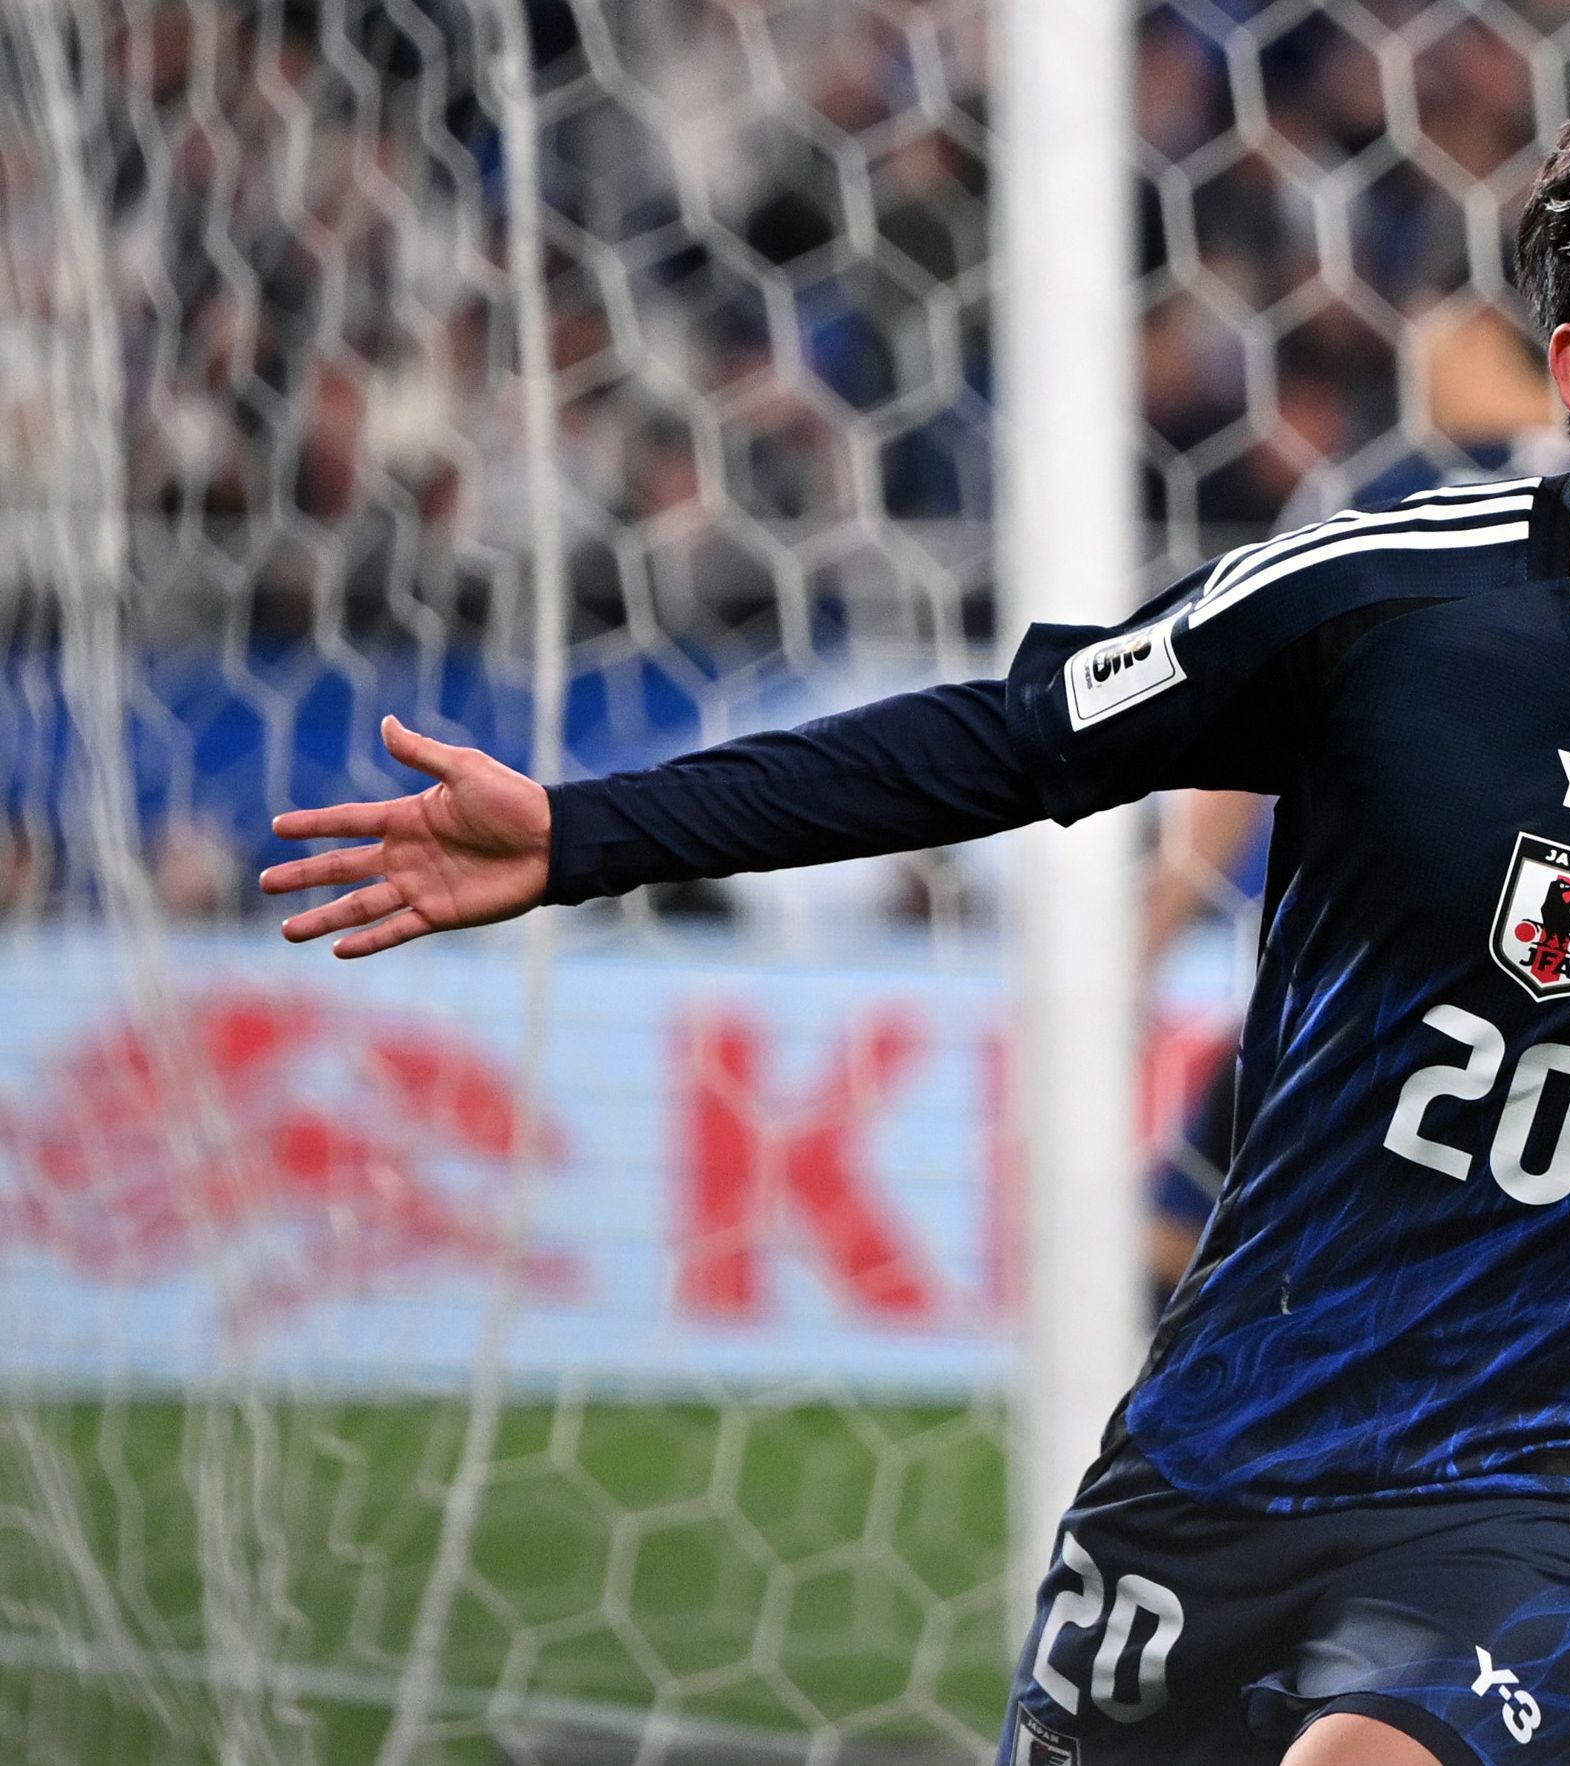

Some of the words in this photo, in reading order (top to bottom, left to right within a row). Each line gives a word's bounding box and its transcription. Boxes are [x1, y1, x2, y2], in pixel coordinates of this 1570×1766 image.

[1032, 1531, 1185, 1724] 20
[1026, 1718, 1060, 1744] JAPAN
[1470, 1645, 1542, 1744] Y-3
